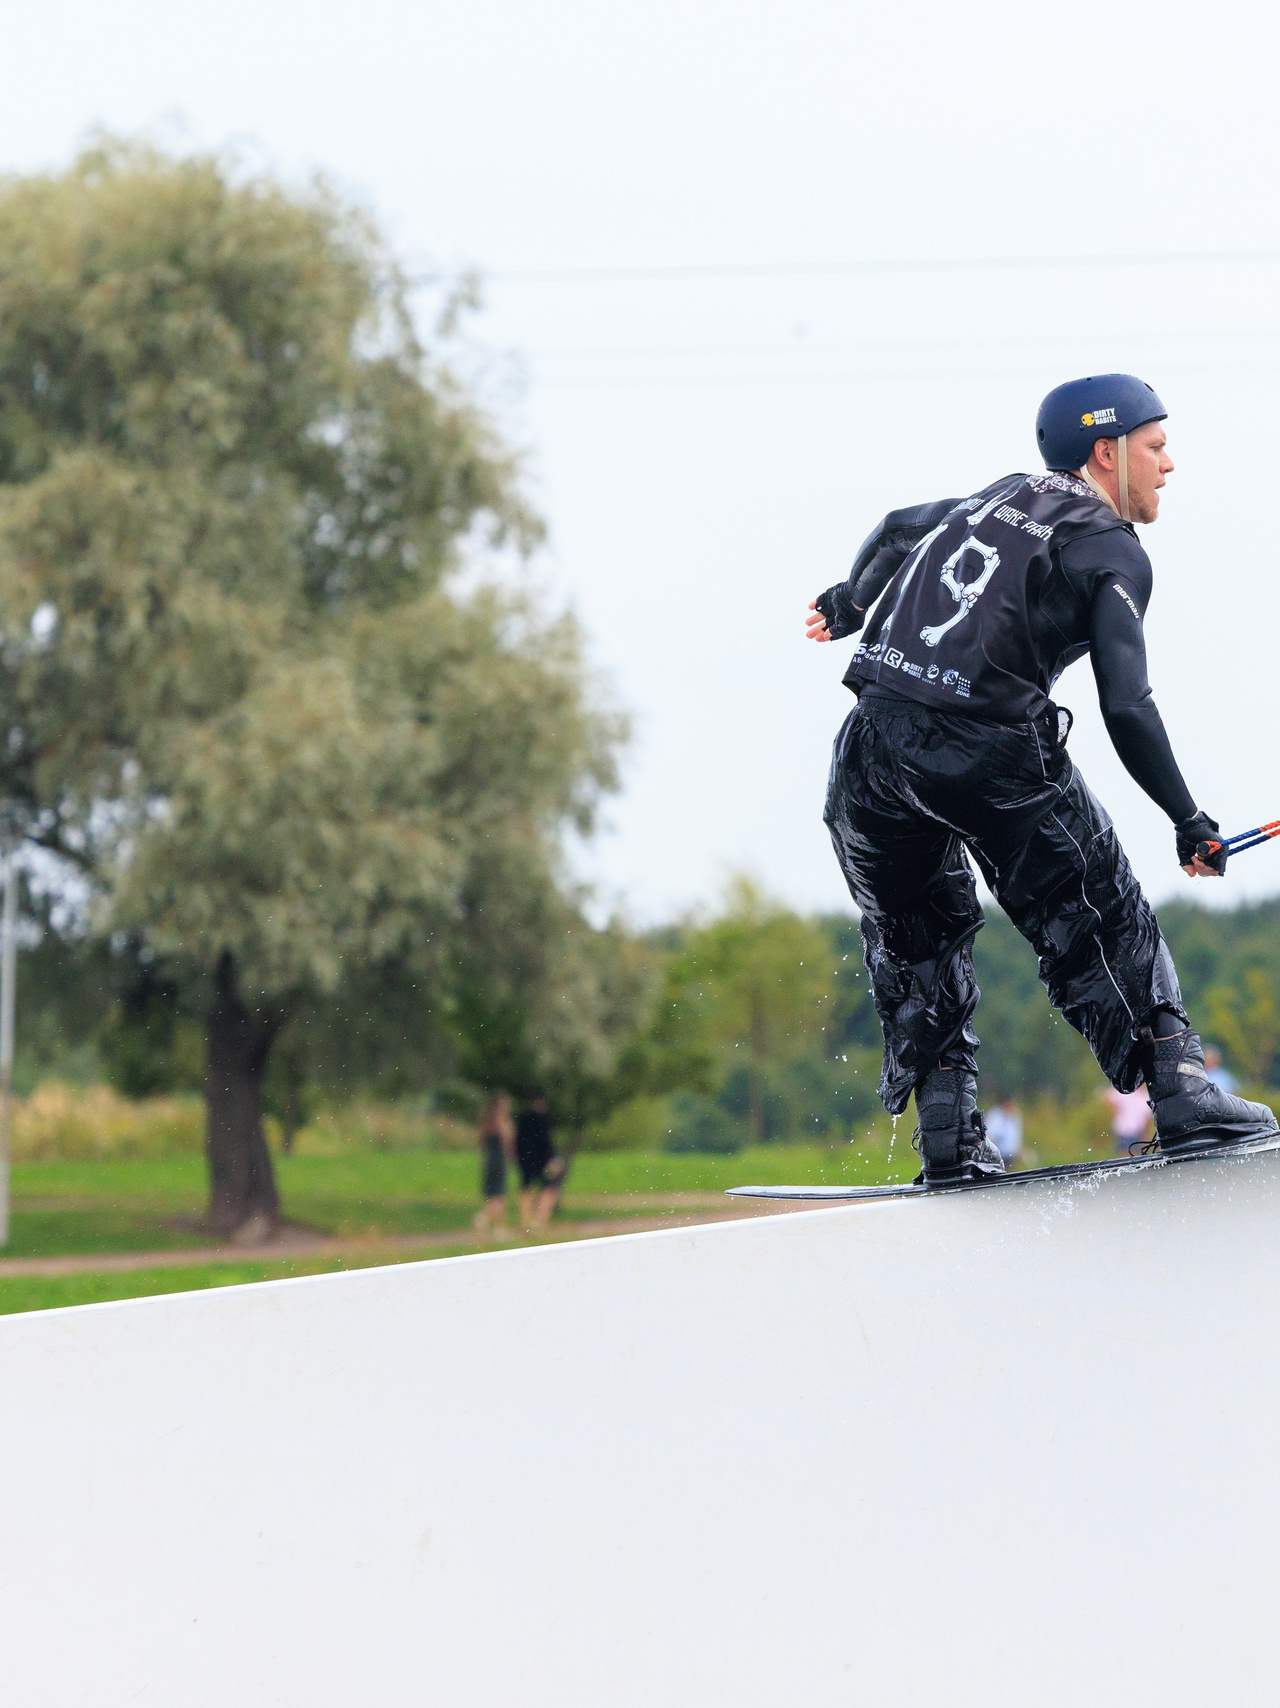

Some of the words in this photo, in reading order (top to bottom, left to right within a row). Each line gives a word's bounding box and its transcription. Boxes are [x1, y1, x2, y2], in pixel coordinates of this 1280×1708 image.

[1093, 407, 1115, 419] DIRTY
[1095, 415, 1117, 426] HABITS
[993, 504, 1028, 527] WAKE
[955, 689, 970, 698] ZONE
